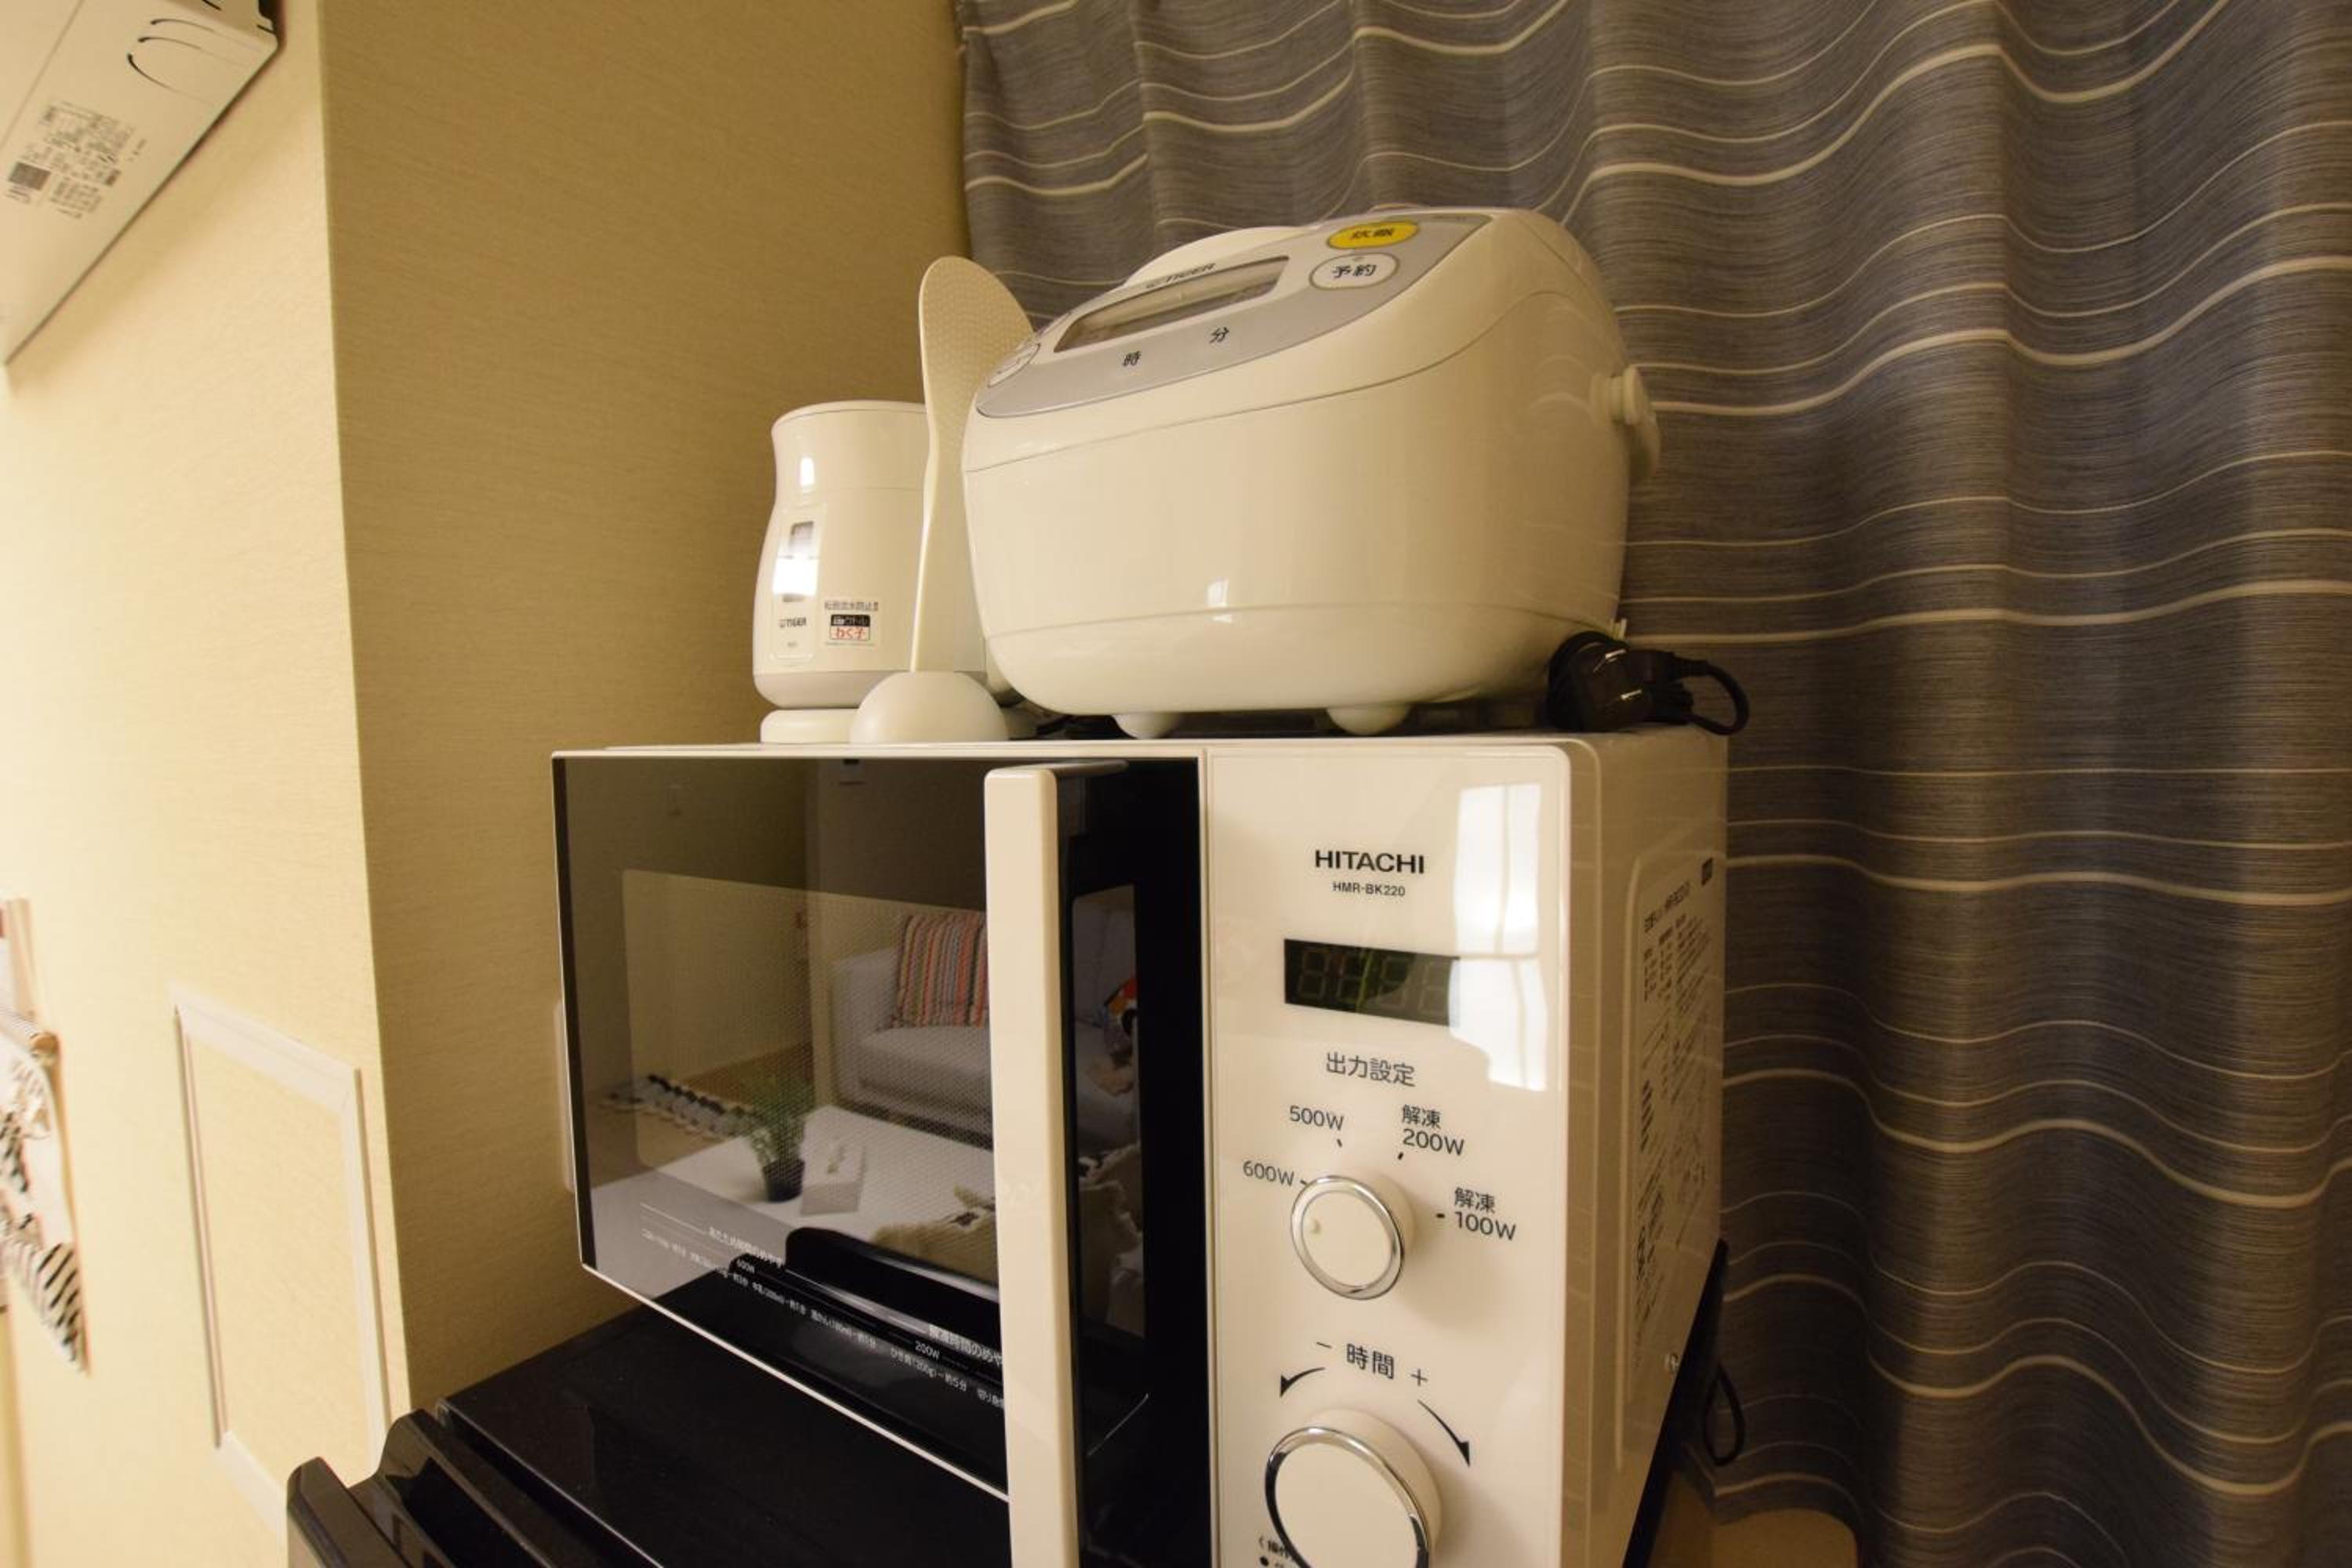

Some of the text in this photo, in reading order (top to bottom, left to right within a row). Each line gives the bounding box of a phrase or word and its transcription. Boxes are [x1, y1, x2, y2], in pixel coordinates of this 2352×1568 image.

[1331, 263, 1377, 279] 予約
[1209, 326, 1230, 344] 分
[1122, 350, 1142, 368] 時
[1314, 849, 1425, 875] HITACHI
[1332, 881, 1406, 898] HMR-BK220
[1326, 1051, 1417, 1088] 出力設定
[1289, 1105, 1345, 1131] 500W
[1401, 1104, 1442, 1130] 解凍
[1402, 1128, 1465, 1157] 200W
[1243, 1160, 1295, 1187] 600W
[1454, 1187, 1496, 1214] 解凍
[1454, 1210, 1517, 1242] 100W
[1345, 1342, 1396, 1380] 時間
